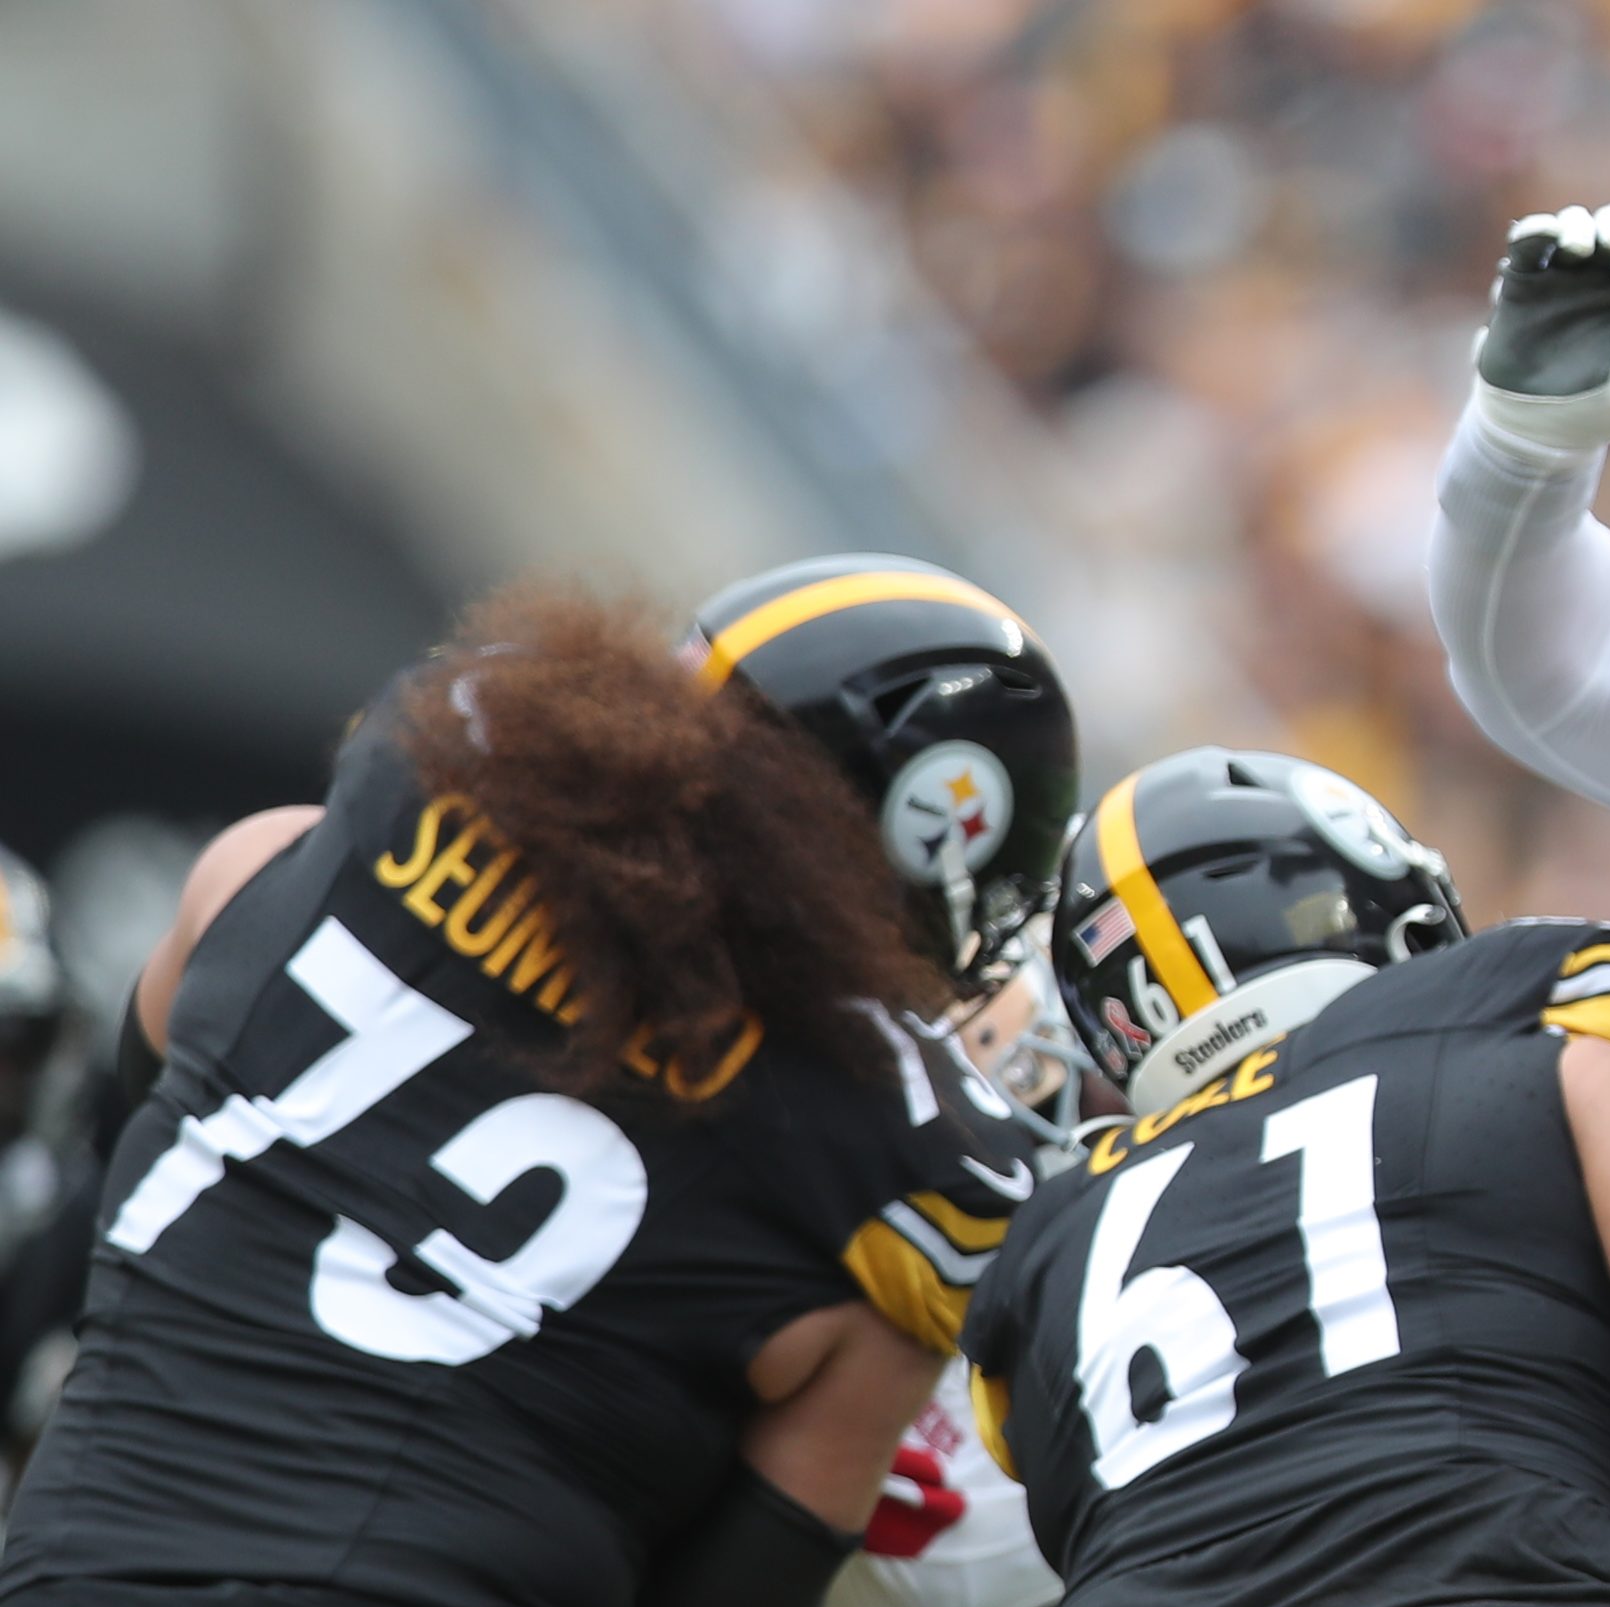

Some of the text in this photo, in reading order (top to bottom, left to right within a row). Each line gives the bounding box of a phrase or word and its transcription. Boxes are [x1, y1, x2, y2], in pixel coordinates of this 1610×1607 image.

[105, 915, 648, 1367] 73
[1127, 914, 1238, 1040] 61
[1076, 1073, 1401, 1492] 61
